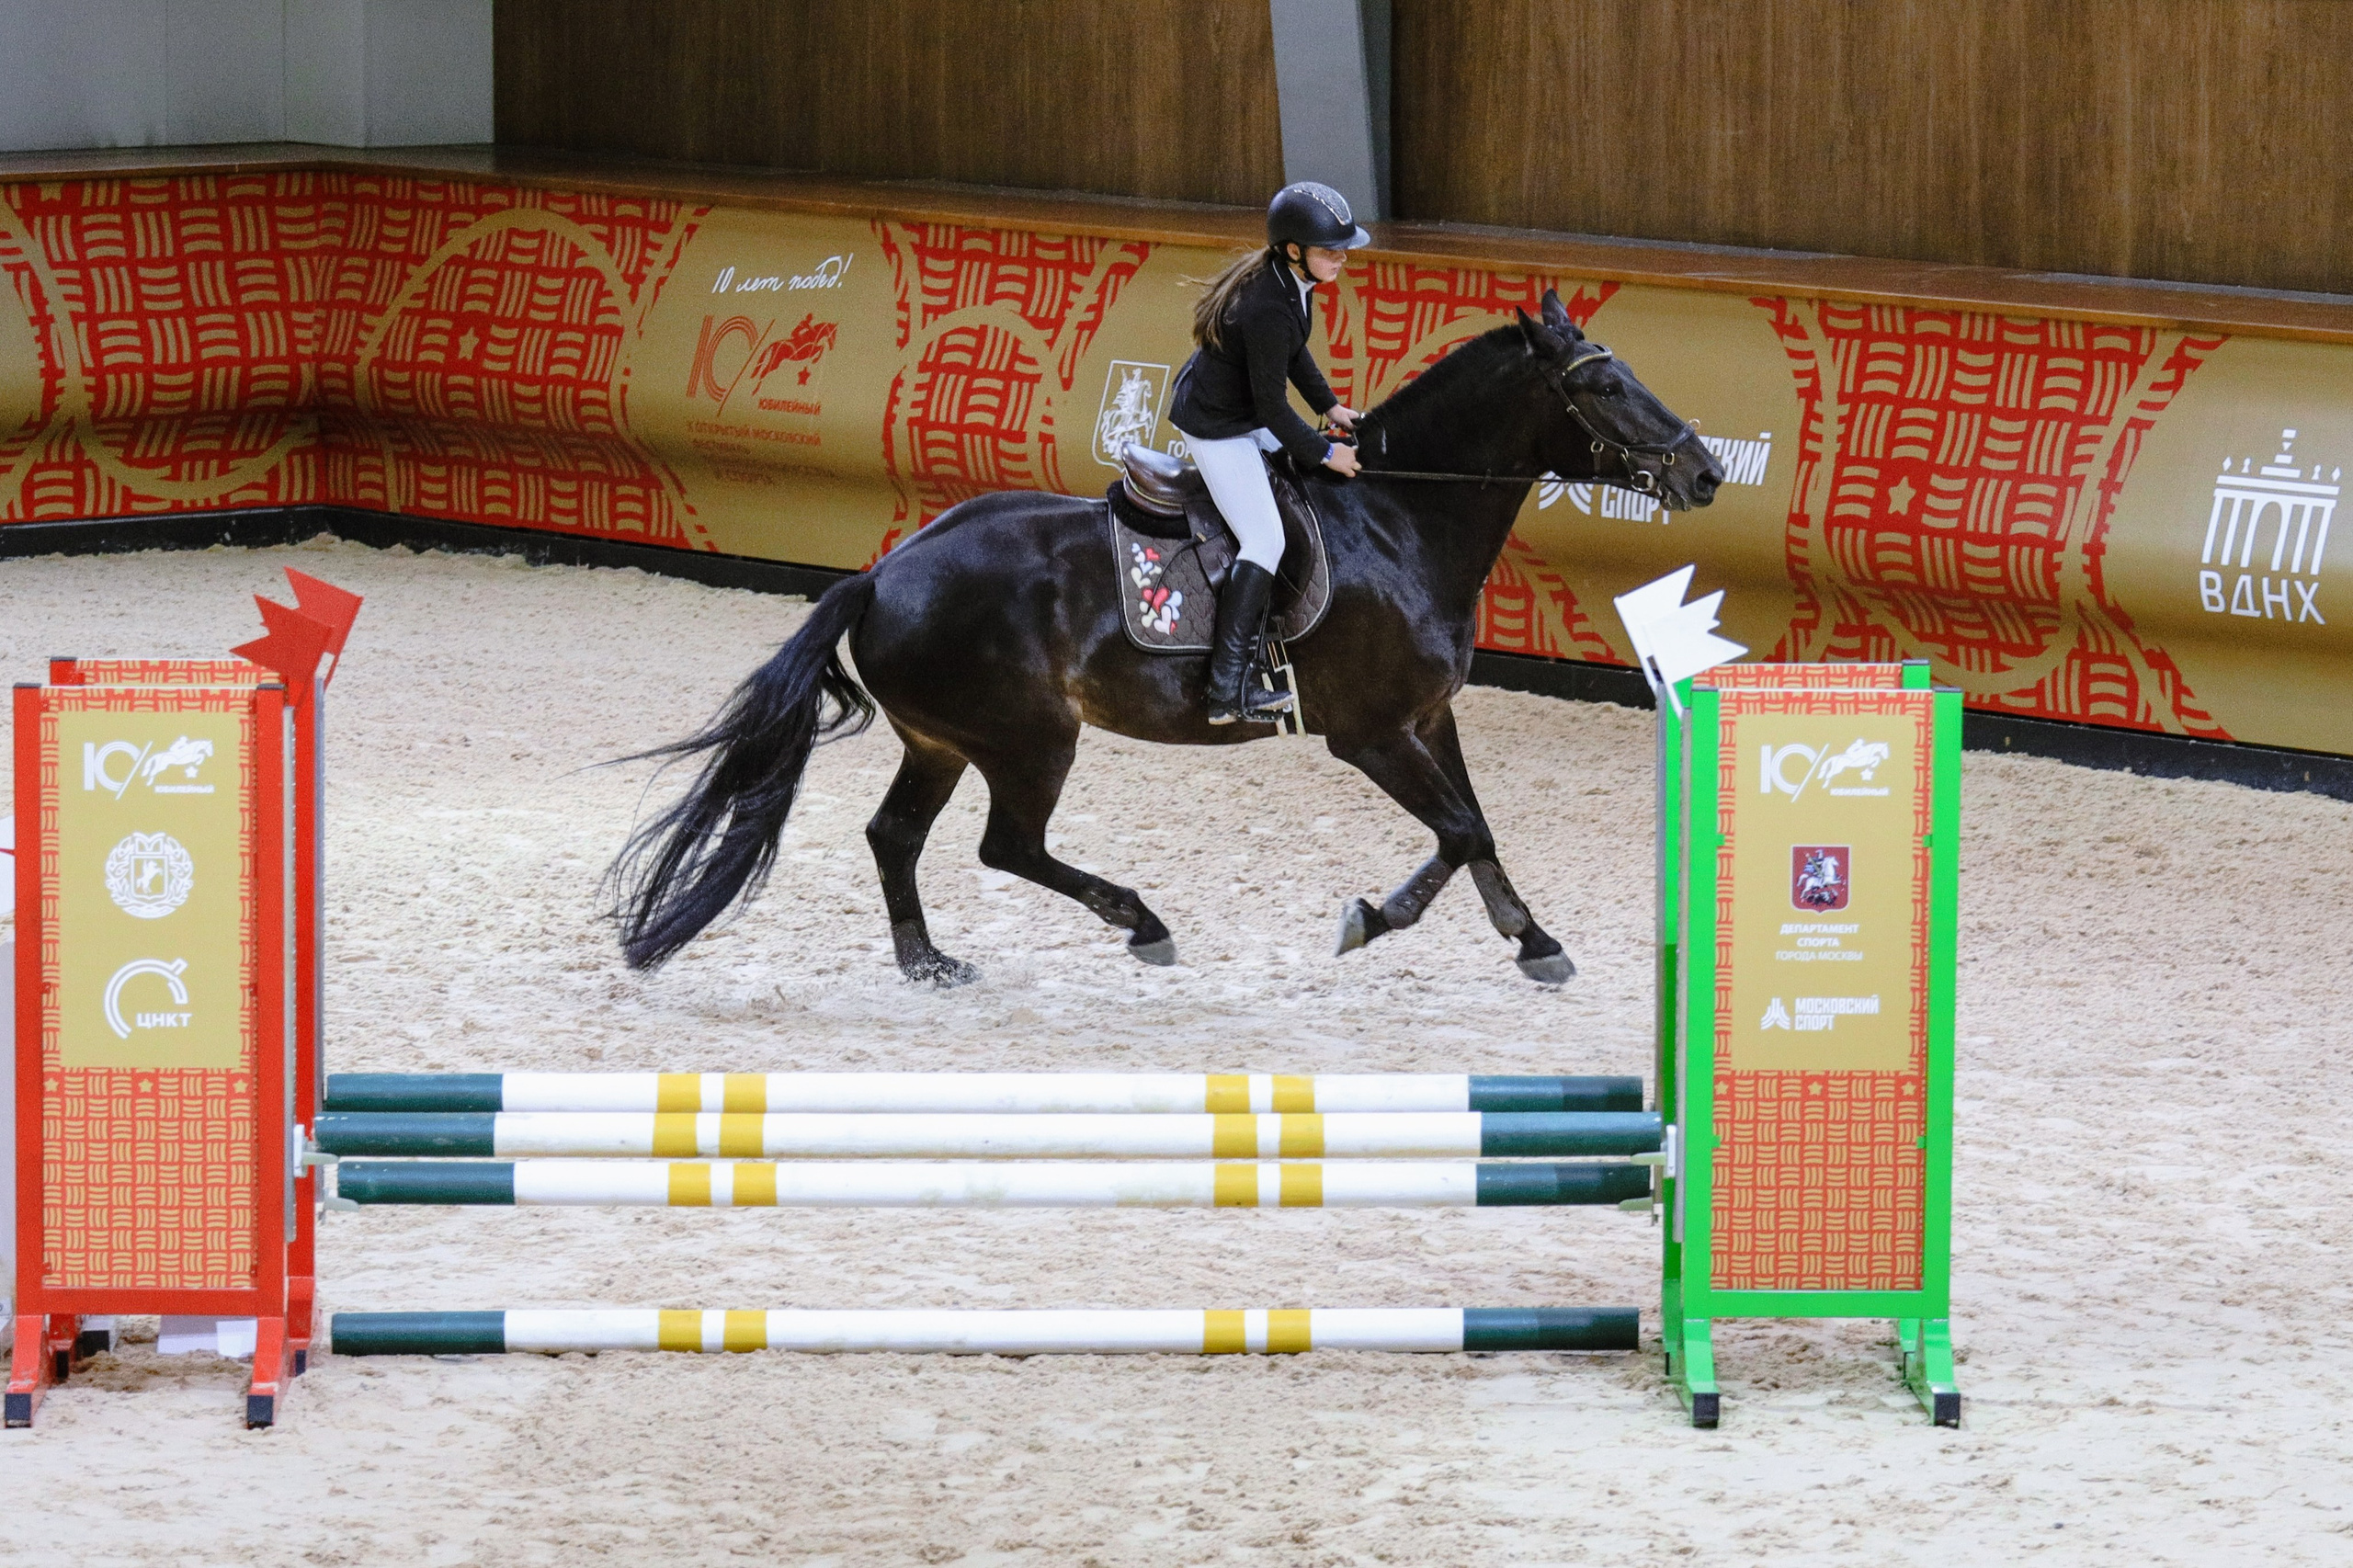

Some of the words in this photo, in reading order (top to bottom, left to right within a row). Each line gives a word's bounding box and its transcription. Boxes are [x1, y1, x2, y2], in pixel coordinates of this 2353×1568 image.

[735, 276, 784, 293] лет
[788, 252, 854, 291] побед!
[2199, 570, 2325, 626] ВДНХ
[1779, 923, 1859, 936] ДЕПАРТАМЕНТ
[1796, 937, 1840, 948] СПОРТА
[1775, 950, 1816, 962] ГОРОДА
[1818, 950, 1863, 961] МОСКВЫ
[1794, 994, 1880, 1015] МОСКОВСКИЙ
[135, 1012, 193, 1029] ЦНКТ
[1794, 1014, 1836, 1030] СПОРТ
